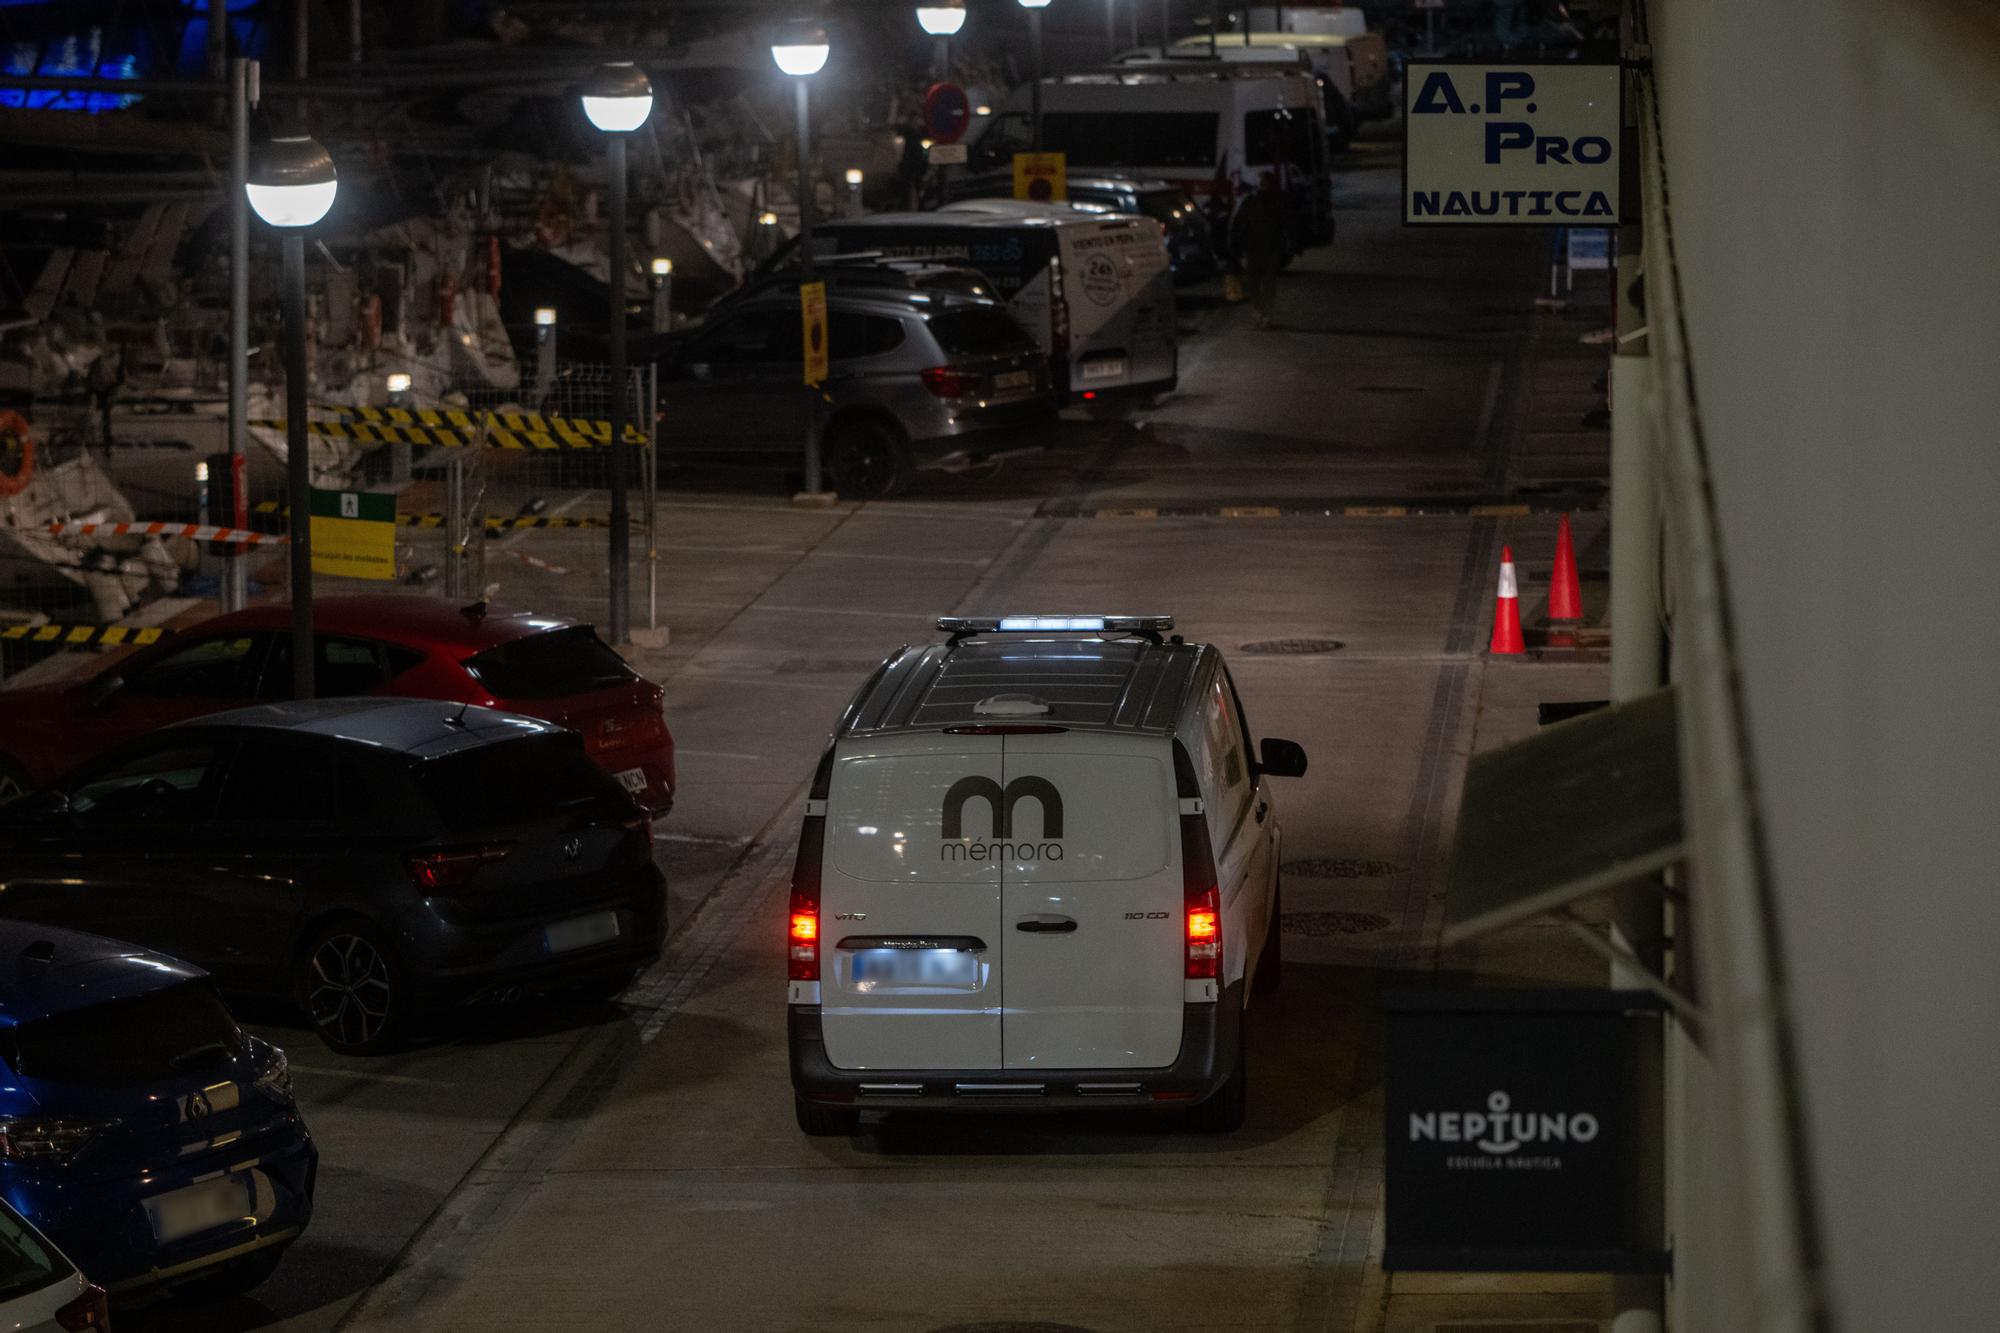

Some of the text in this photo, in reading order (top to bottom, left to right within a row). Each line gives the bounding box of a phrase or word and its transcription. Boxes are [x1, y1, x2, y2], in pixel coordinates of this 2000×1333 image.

[1411, 72, 1537, 113] A.P.
[1413, 191, 1613, 215] NAUTICA
[942, 836, 1063, 860] mémora
[1408, 1090, 1600, 1154] NEPTUNO
[1447, 1157, 1503, 1169] ESCUELA
